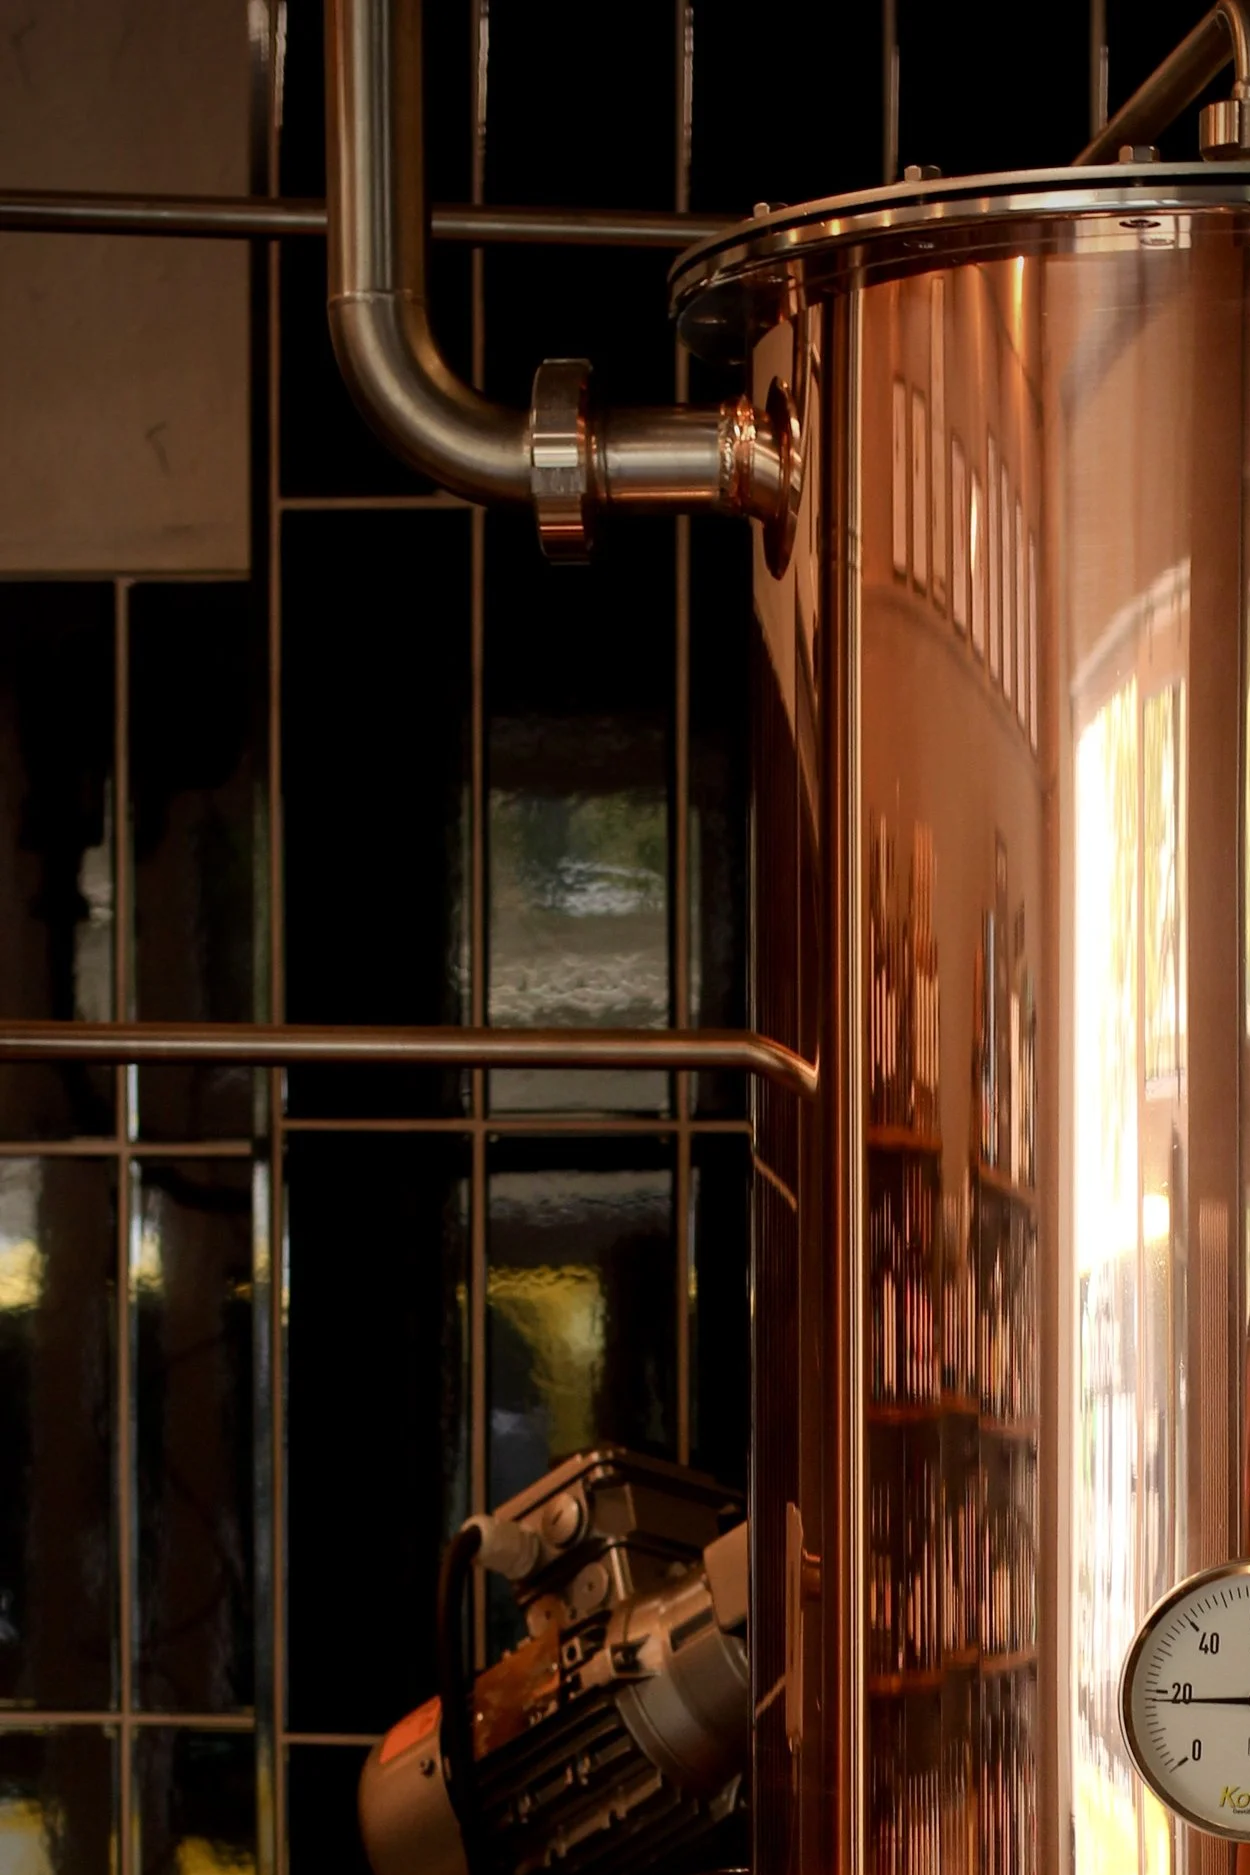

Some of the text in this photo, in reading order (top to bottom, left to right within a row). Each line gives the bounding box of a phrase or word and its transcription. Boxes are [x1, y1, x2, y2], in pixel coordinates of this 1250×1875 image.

[1199, 1632, 1219, 1654] 40
[1171, 1683, 1193, 1705] 20
[1192, 1739, 1202, 1761] 0
